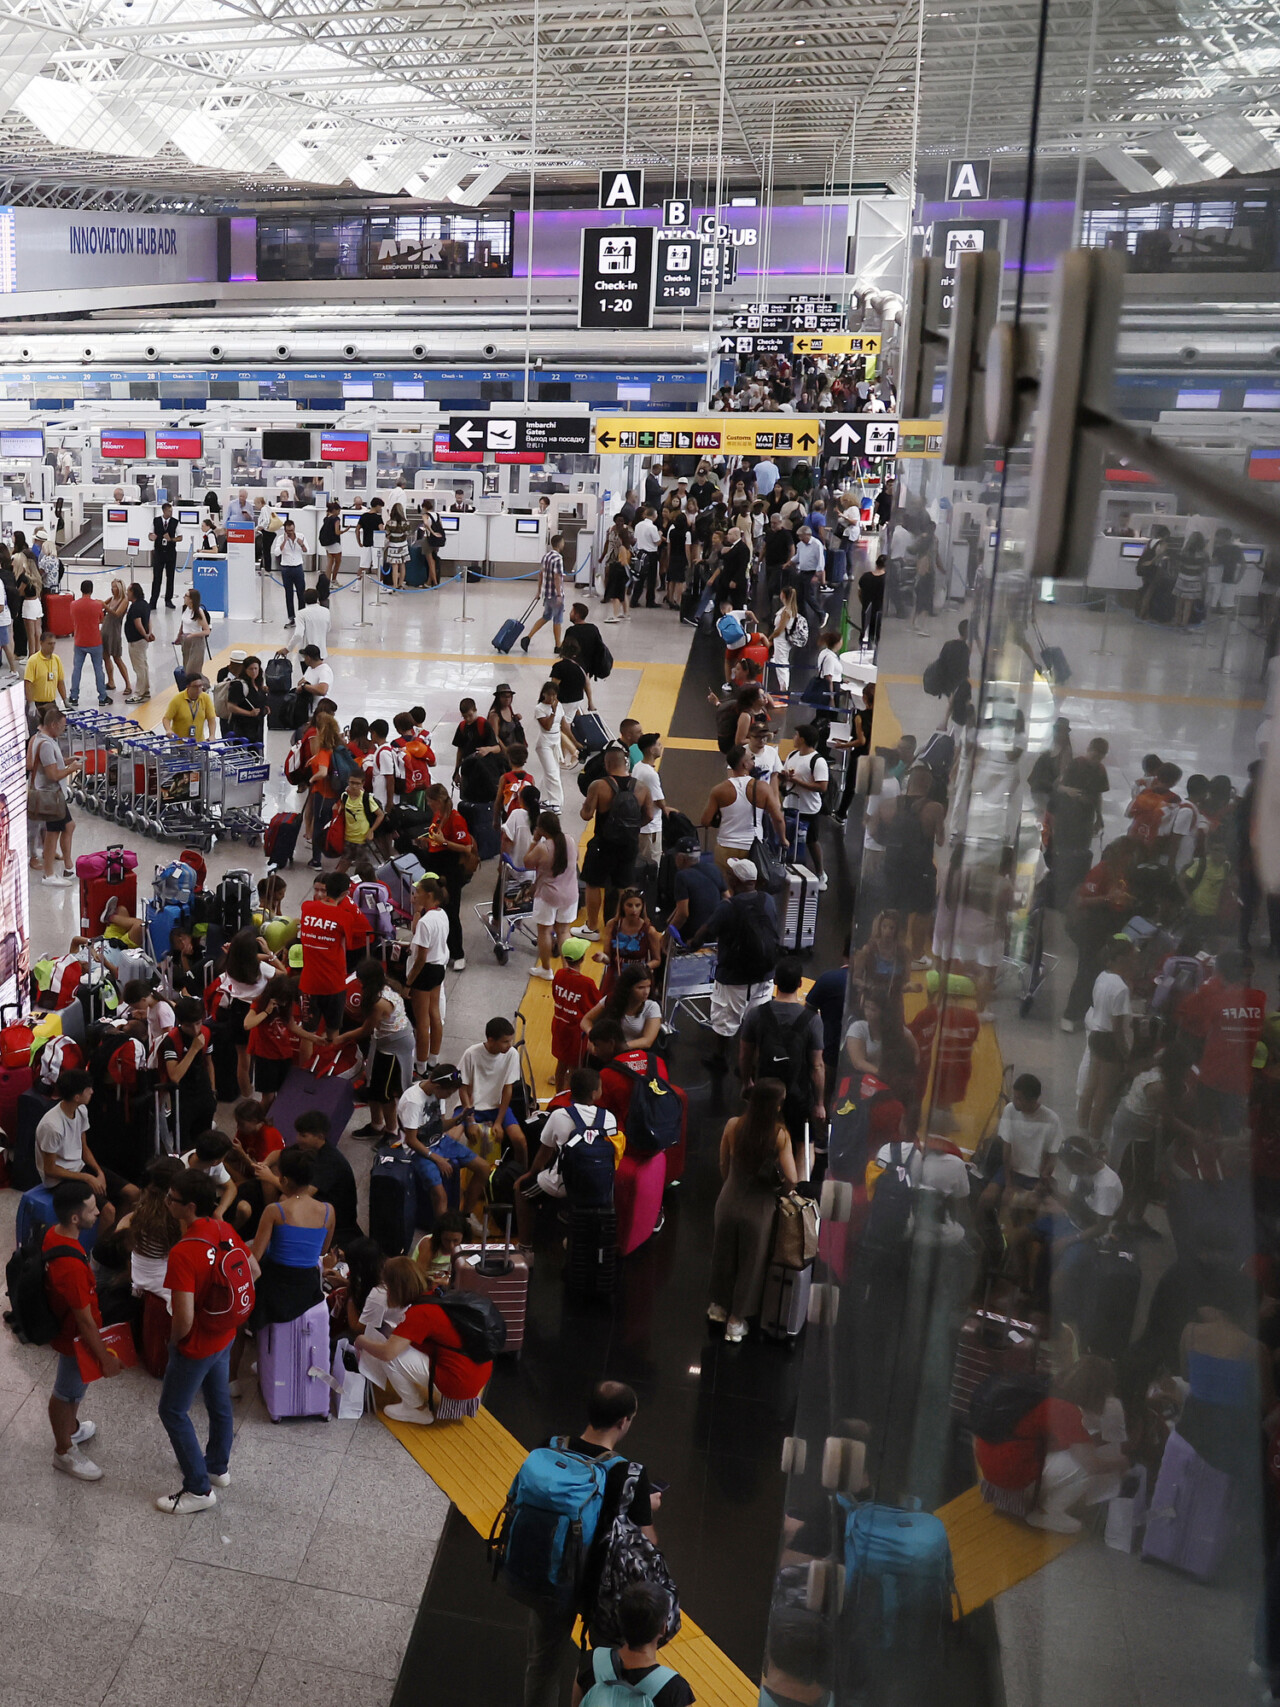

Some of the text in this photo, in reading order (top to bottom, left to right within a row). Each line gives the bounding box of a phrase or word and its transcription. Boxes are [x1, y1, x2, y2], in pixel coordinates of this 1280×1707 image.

[606, 174, 636, 206] A
[669, 202, 685, 224] B
[704, 217, 716, 233] C
[70, 226, 177, 255] INNOVATION HUB ADR
[378, 239, 442, 261] ADR
[594, 281, 638, 291] Check-in
[663, 275, 691, 283] Check-in
[663, 287, 691, 297] 21-50
[599, 299, 634, 312] 1-20
[304, 916, 337, 931] STAFF
